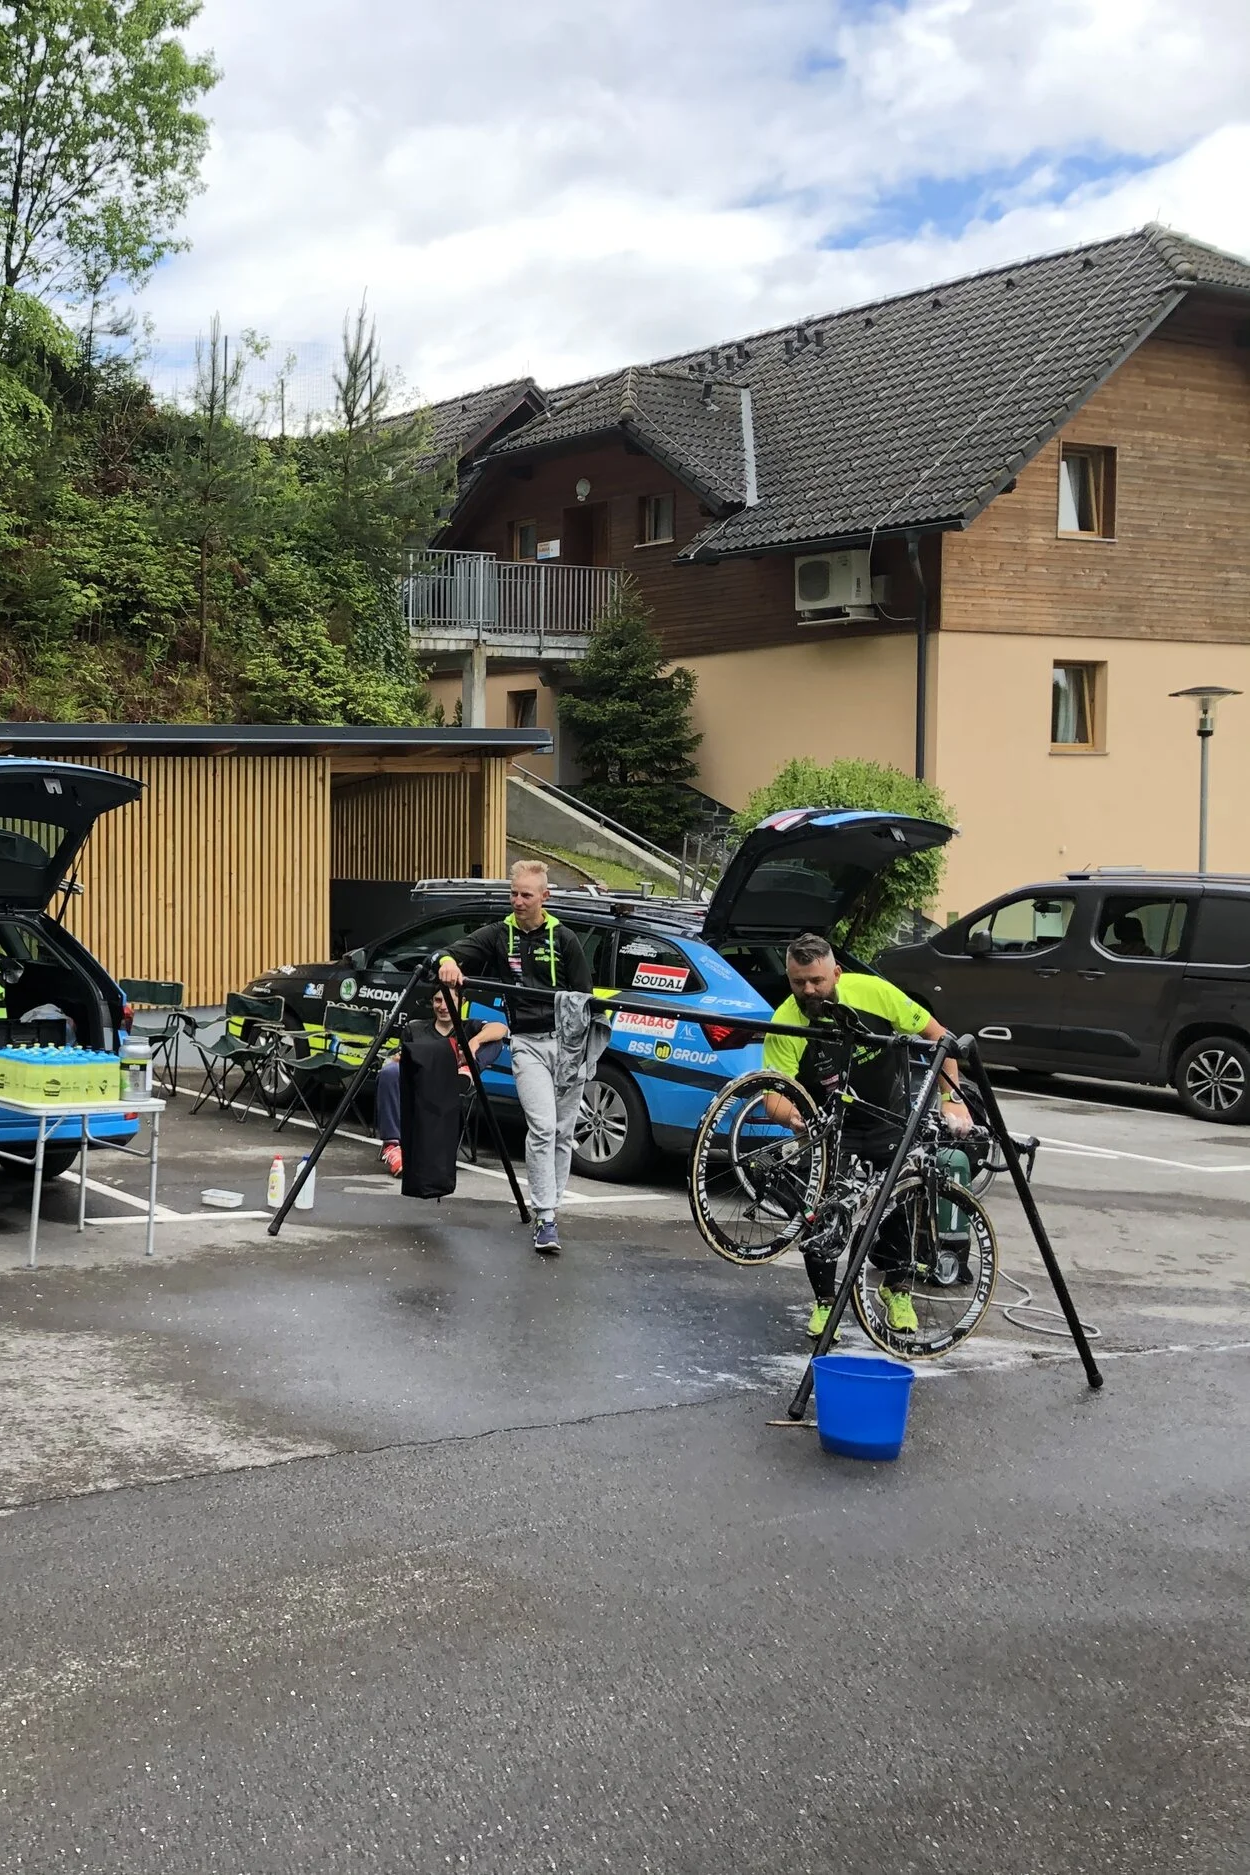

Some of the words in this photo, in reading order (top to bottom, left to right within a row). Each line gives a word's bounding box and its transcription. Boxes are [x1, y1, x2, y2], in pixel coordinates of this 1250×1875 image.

[634, 974, 683, 991] SOUDAL
[358, 985, 403, 1003] ŠKODA
[617, 1013, 675, 1030] STRABAG
[628, 1040, 653, 1054] BSS
[673, 1048, 718, 1065] GROUP
[969, 1212, 987, 1233] NO
[977, 1236, 994, 1303] LIMITED
